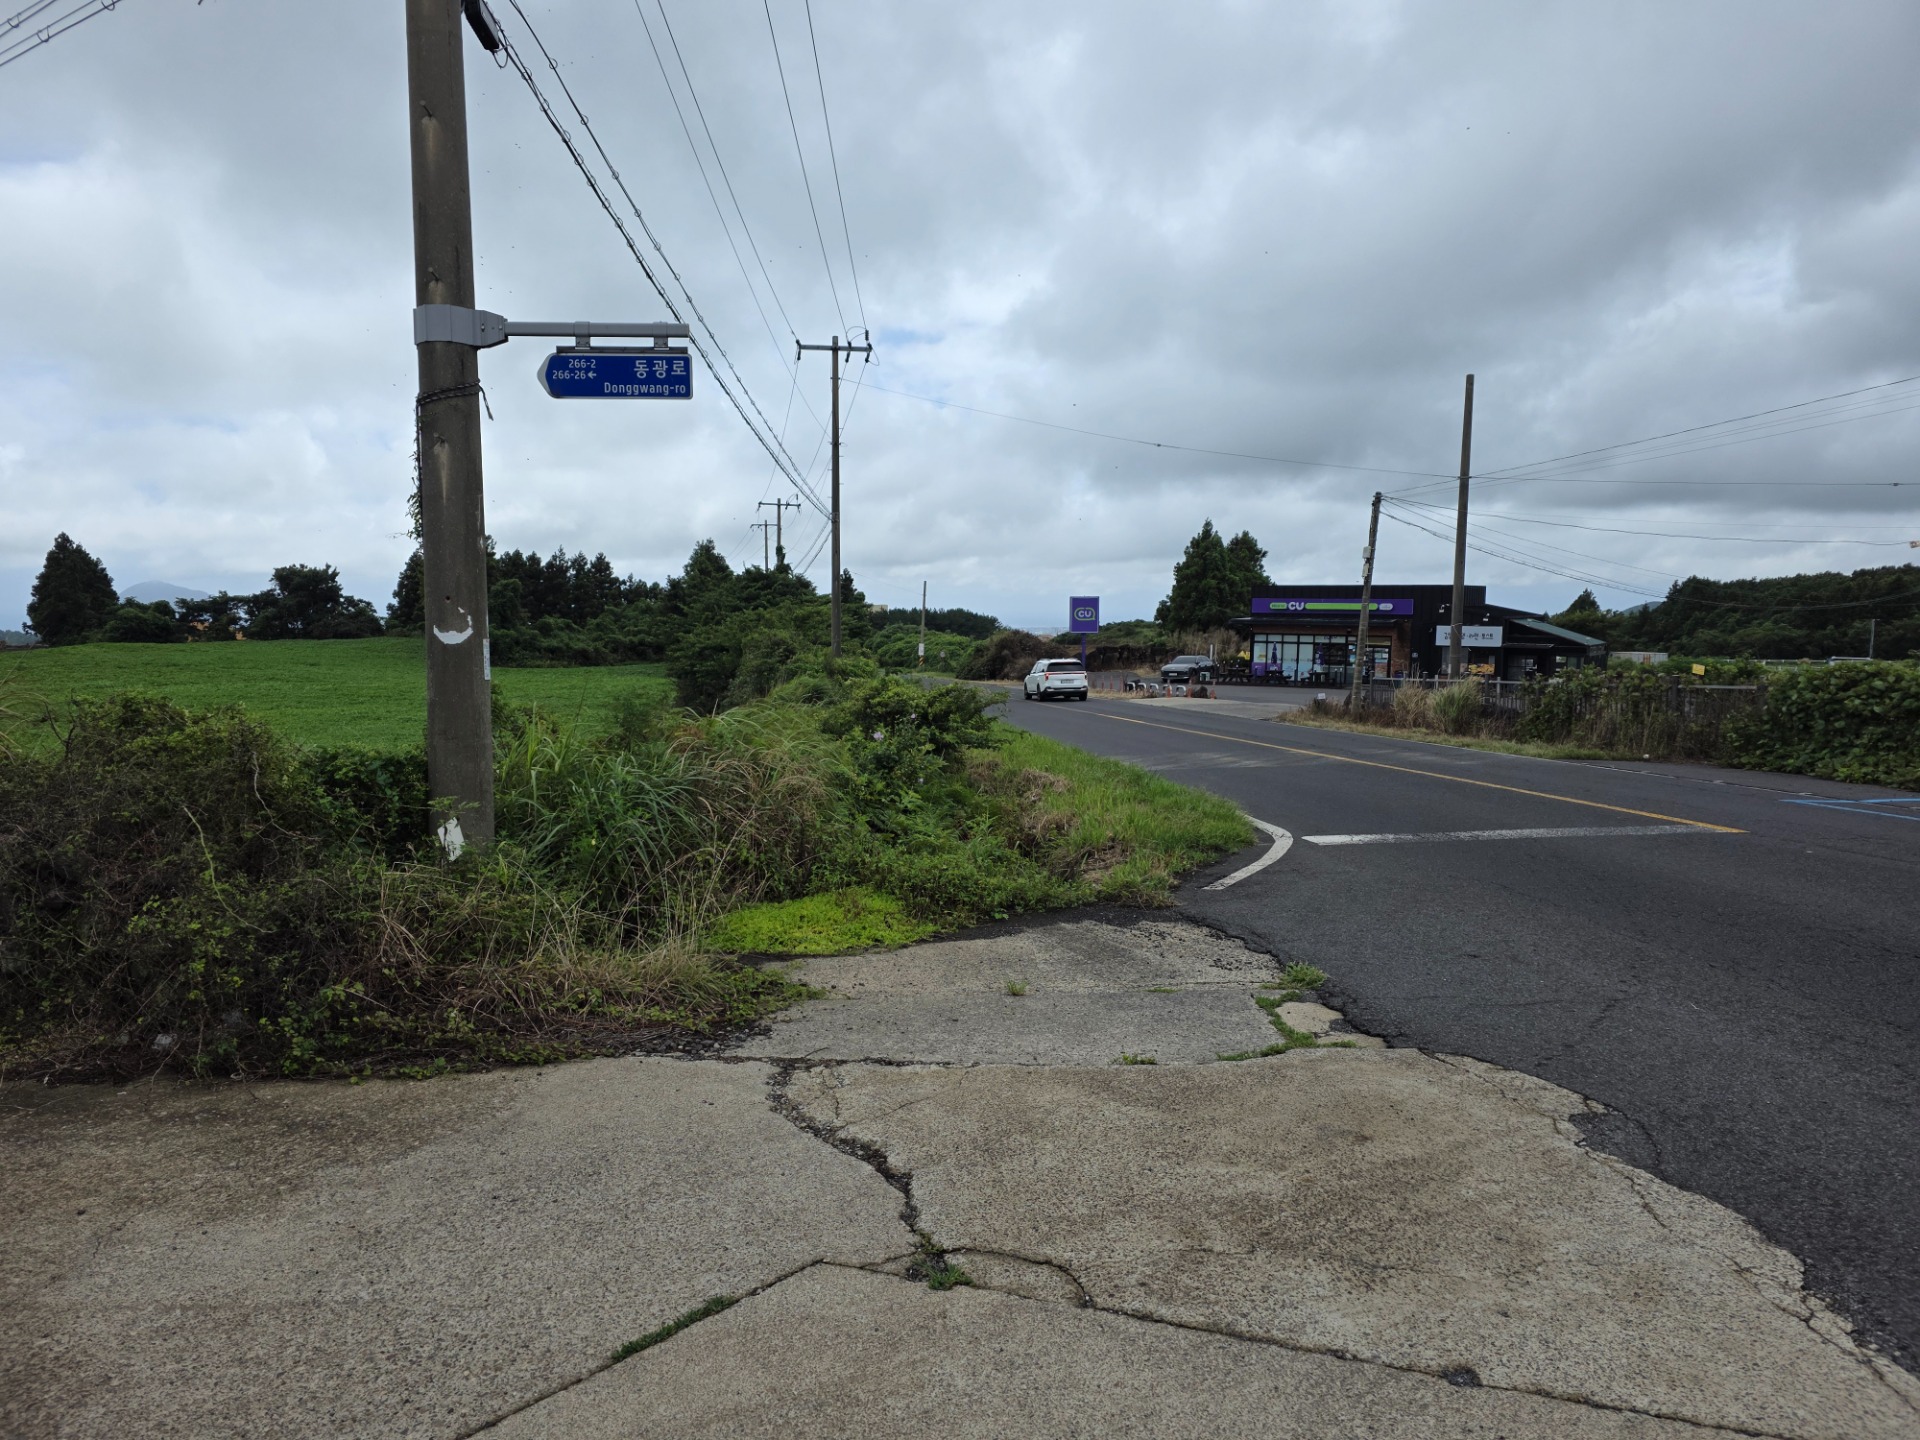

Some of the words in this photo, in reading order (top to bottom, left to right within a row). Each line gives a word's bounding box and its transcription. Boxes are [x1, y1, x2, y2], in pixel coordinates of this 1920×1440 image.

[568, 359, 596, 368] 266-2
[633, 359, 687, 379] 동광로
[552, 370, 586, 379] 266-26
[604, 382, 686, 395] Donggwang-ro
[1288, 601, 1304, 610] CU
[1078, 610, 1091, 618] CU
